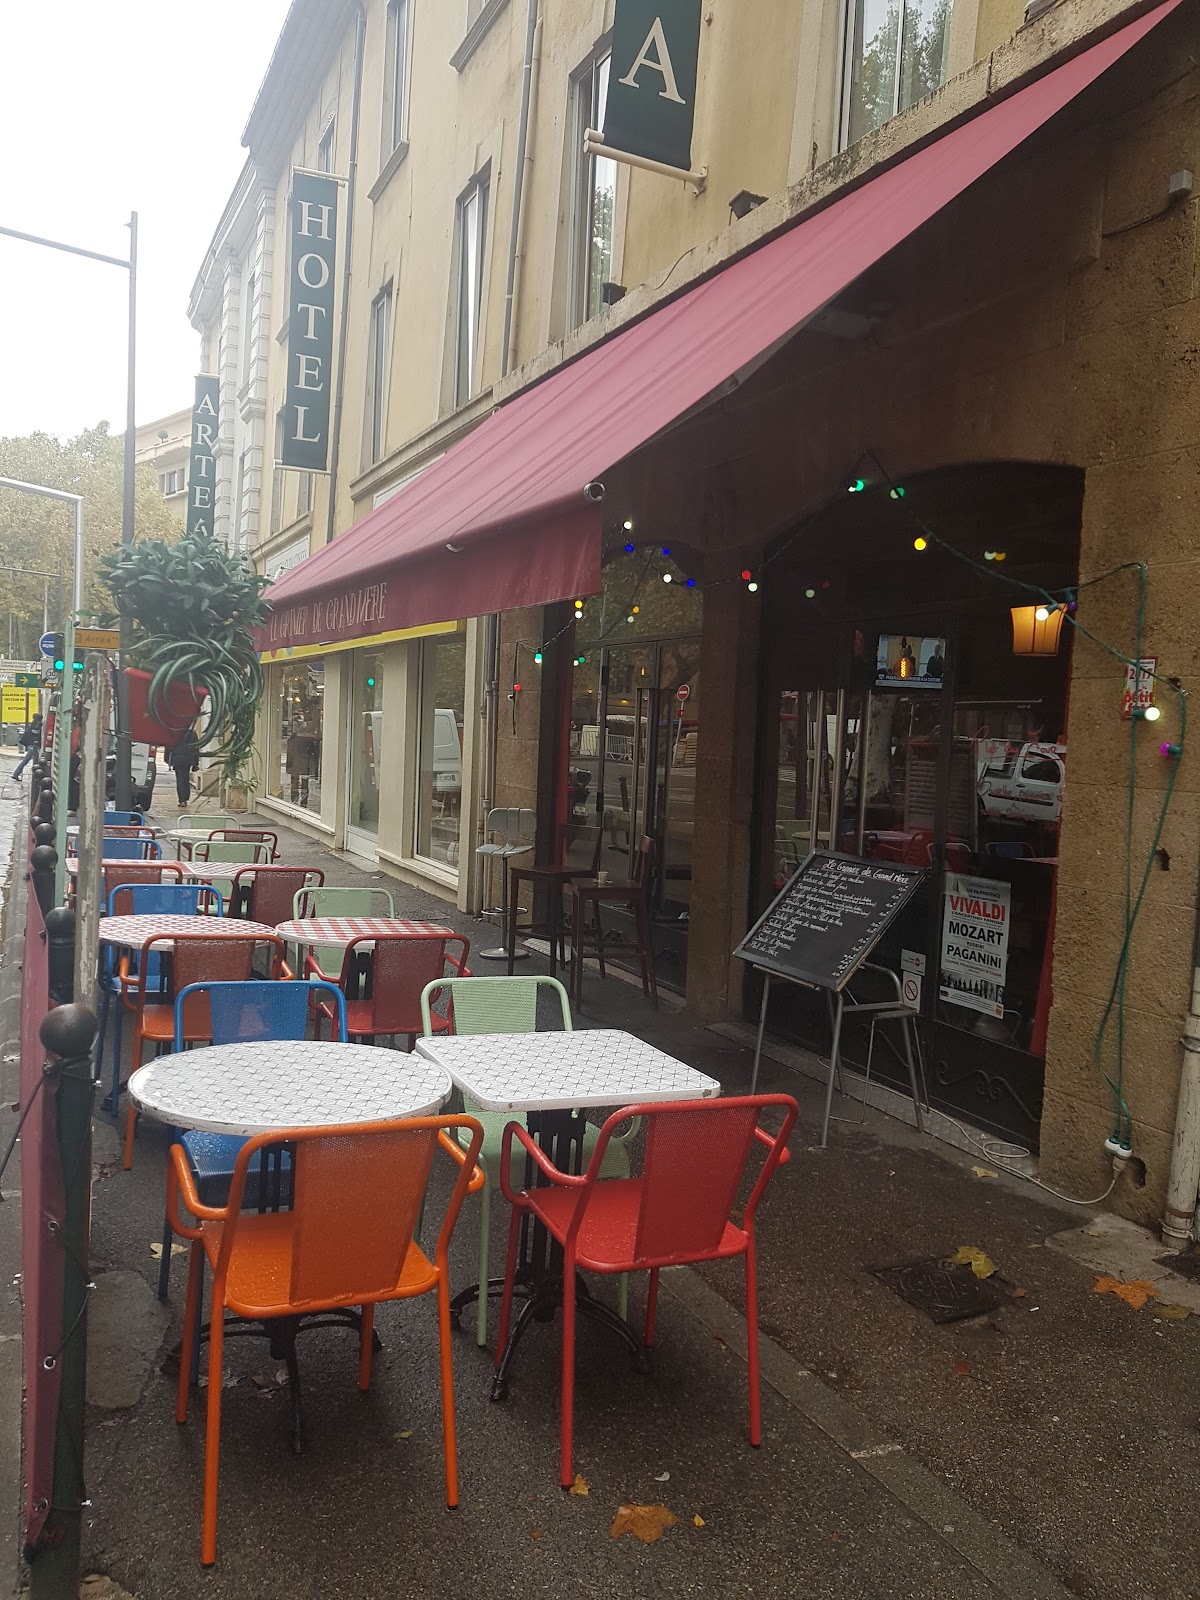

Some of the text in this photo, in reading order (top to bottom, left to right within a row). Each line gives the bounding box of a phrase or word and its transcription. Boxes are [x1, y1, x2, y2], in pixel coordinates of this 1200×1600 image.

[292, 199, 333, 444] HOTEL
[270, 614, 279, 641] LE
[280, 606, 308, 639] GRENIER
[312, 602, 322, 633] DE
[822, 859, 836, 869] Le
[861, 866, 872, 876] de
[873, 869, 895, 882] Grand
[949, 894, 1006, 922] VIVALDI
[948, 920, 1004, 946] MOZART
[966, 941, 985, 950] ROSSINI
[946, 944, 1002, 969] PAGANINI
